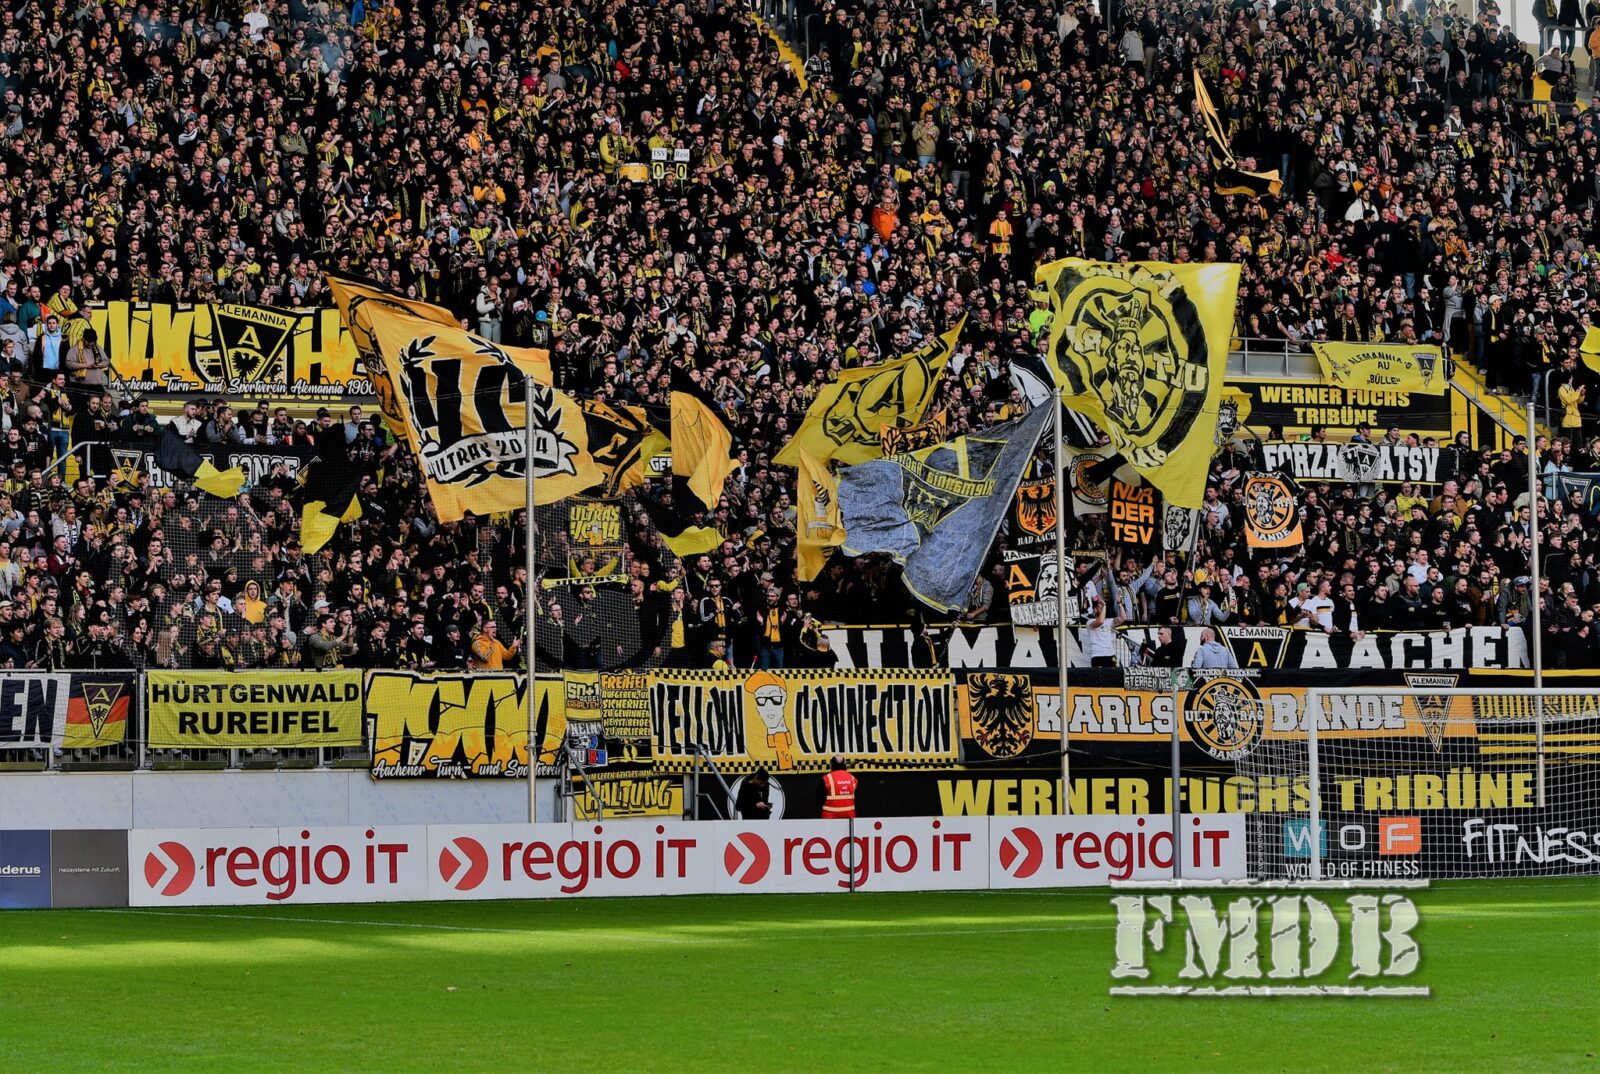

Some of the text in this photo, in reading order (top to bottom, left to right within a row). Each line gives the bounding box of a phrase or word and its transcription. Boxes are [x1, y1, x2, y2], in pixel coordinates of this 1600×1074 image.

[217, 304, 288, 327] ALEMANNIA
[237, 324, 262, 350] A
[1377, 361, 1390, 370] AU
[204, 379, 225, 394] und
[227, 377, 286, 394] Sportverein
[290, 379, 344, 395] Alemannia
[1260, 386, 1411, 408] WERNER FUCHS
[1293, 406, 1378, 427] TRIBÜNE
[496, 436, 549, 457] 204
[1262, 444, 1440, 482] FORZA ATSV
[1112, 480, 1154, 503] NUR
[1111, 504, 1154, 524] DER
[1035, 530, 1067, 543] AACHN
[1111, 523, 1154, 545] TSV
[1010, 599, 1080, 624] KARLSBADE
[1226, 627, 1285, 639] ALEMANNIA
[1246, 641, 1268, 667] A
[152, 679, 360, 704] HÜRTGENWALD
[1411, 677, 1453, 686] ALEMANNIA
[92, 687, 111, 702] A
[178, 710, 339, 735] RUREIFEL
[650, 682, 950, 756] YELLOW CONNECTION
[1036, 694, 1174, 734] KARLS
[1270, 693, 1406, 732] BANDE
[373, 759, 426, 778] Aachener
[479, 760, 500, 776] und
[585, 780, 672, 812] HALTUNG
[938, 767, 1535, 816] WERNER FUCHS TRIBÜNE
[502, 824, 697, 893] regio iT
[784, 820, 971, 888] regio iT
[1055, 817, 1174, 880] regio
[1192, 816, 1230, 867] iT
[0, 865, 41, 875] derus
[206, 828, 409, 901] regio iT
[1285, 860, 1419, 878] WOLD OF FITNESS
